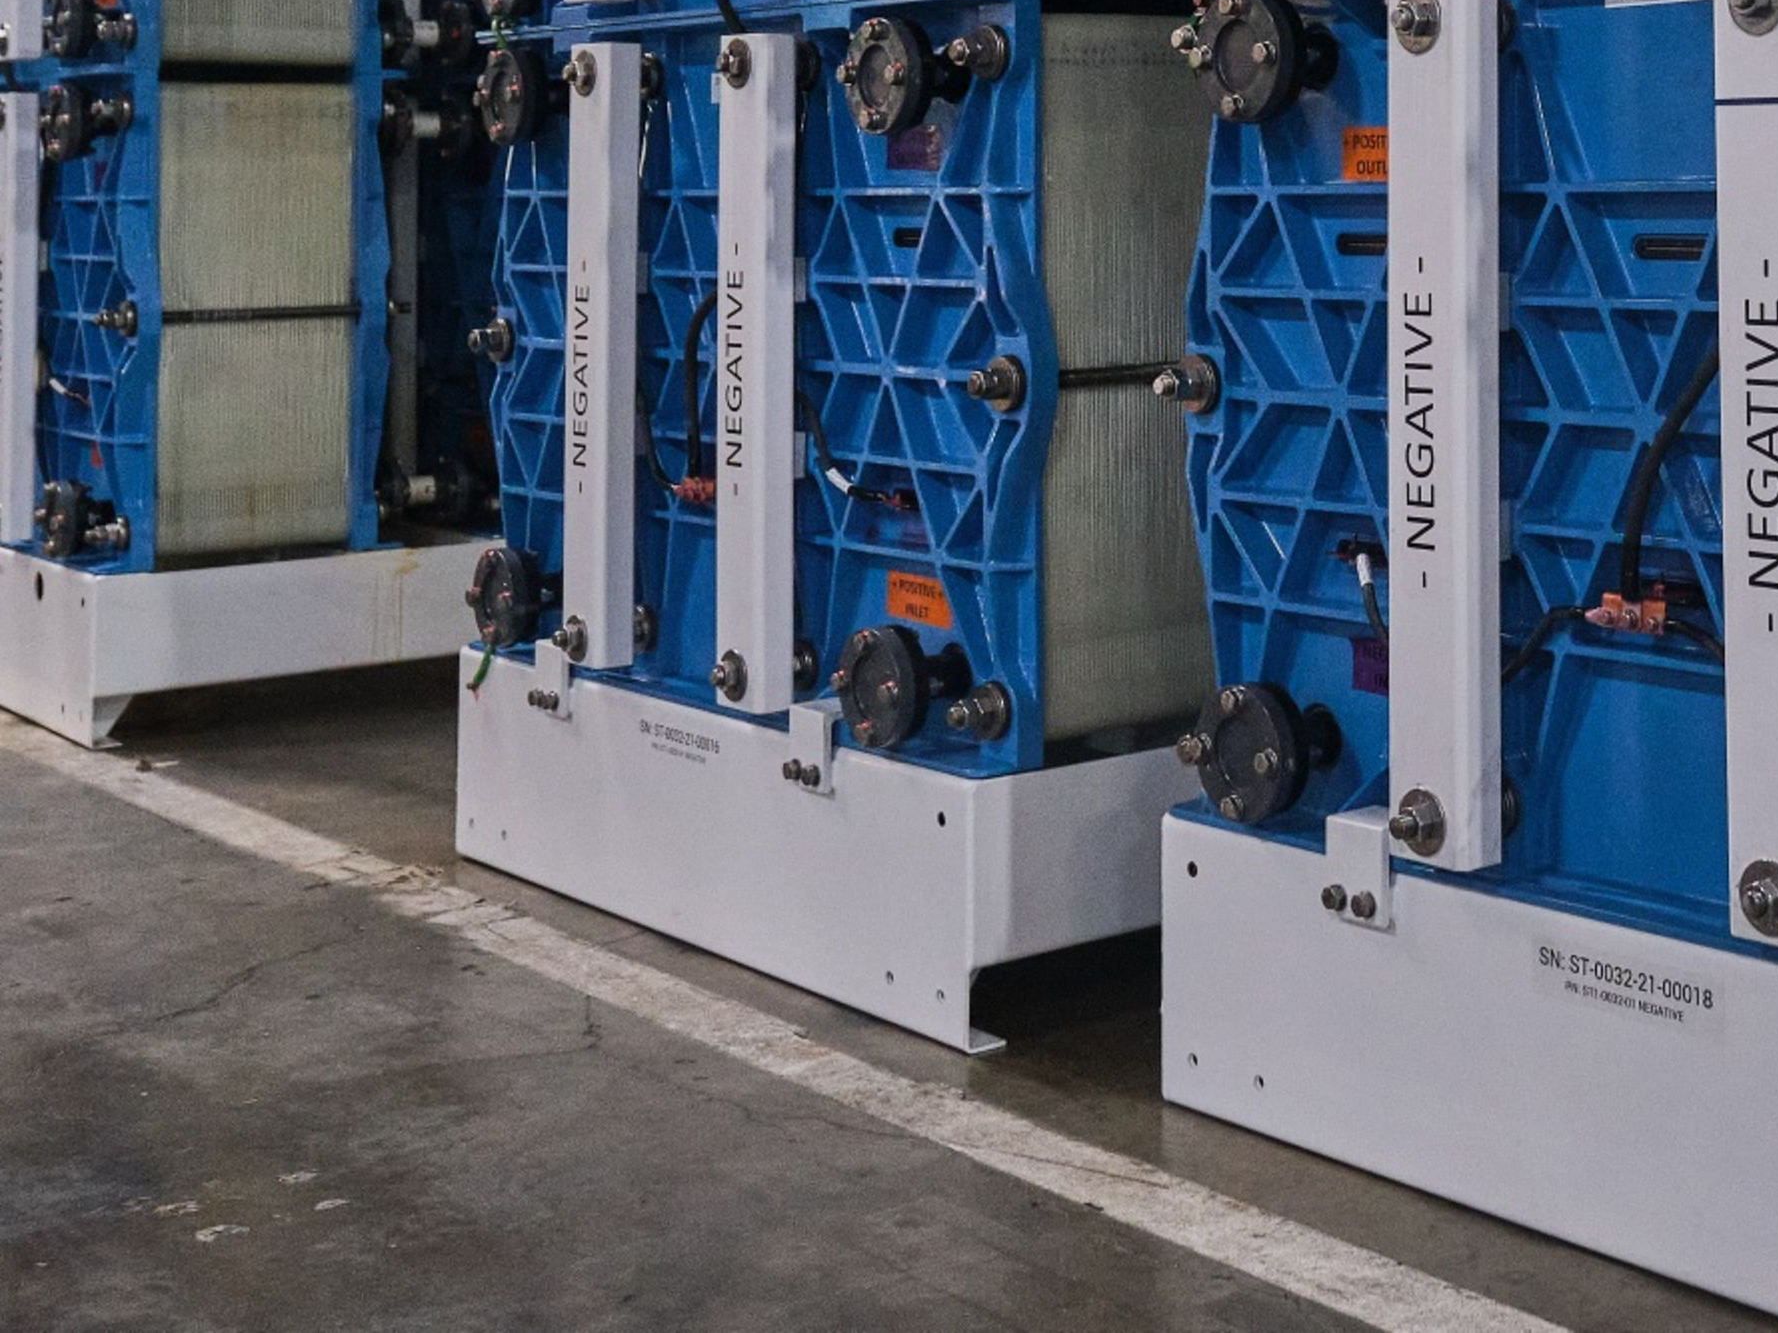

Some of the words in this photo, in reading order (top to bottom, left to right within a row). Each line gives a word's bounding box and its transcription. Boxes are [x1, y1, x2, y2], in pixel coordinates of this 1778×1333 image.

[572, 285, 590, 468] NEGATIVE
[725, 270, 744, 469] NEGATIVE
[1403, 292, 1436, 552] NEGATIVE
[1538, 946, 1566, 970] SN:
[1569, 954, 1714, 1009] ST-0032-21-00018
[1638, 999, 1685, 1023] NEGATIVE
